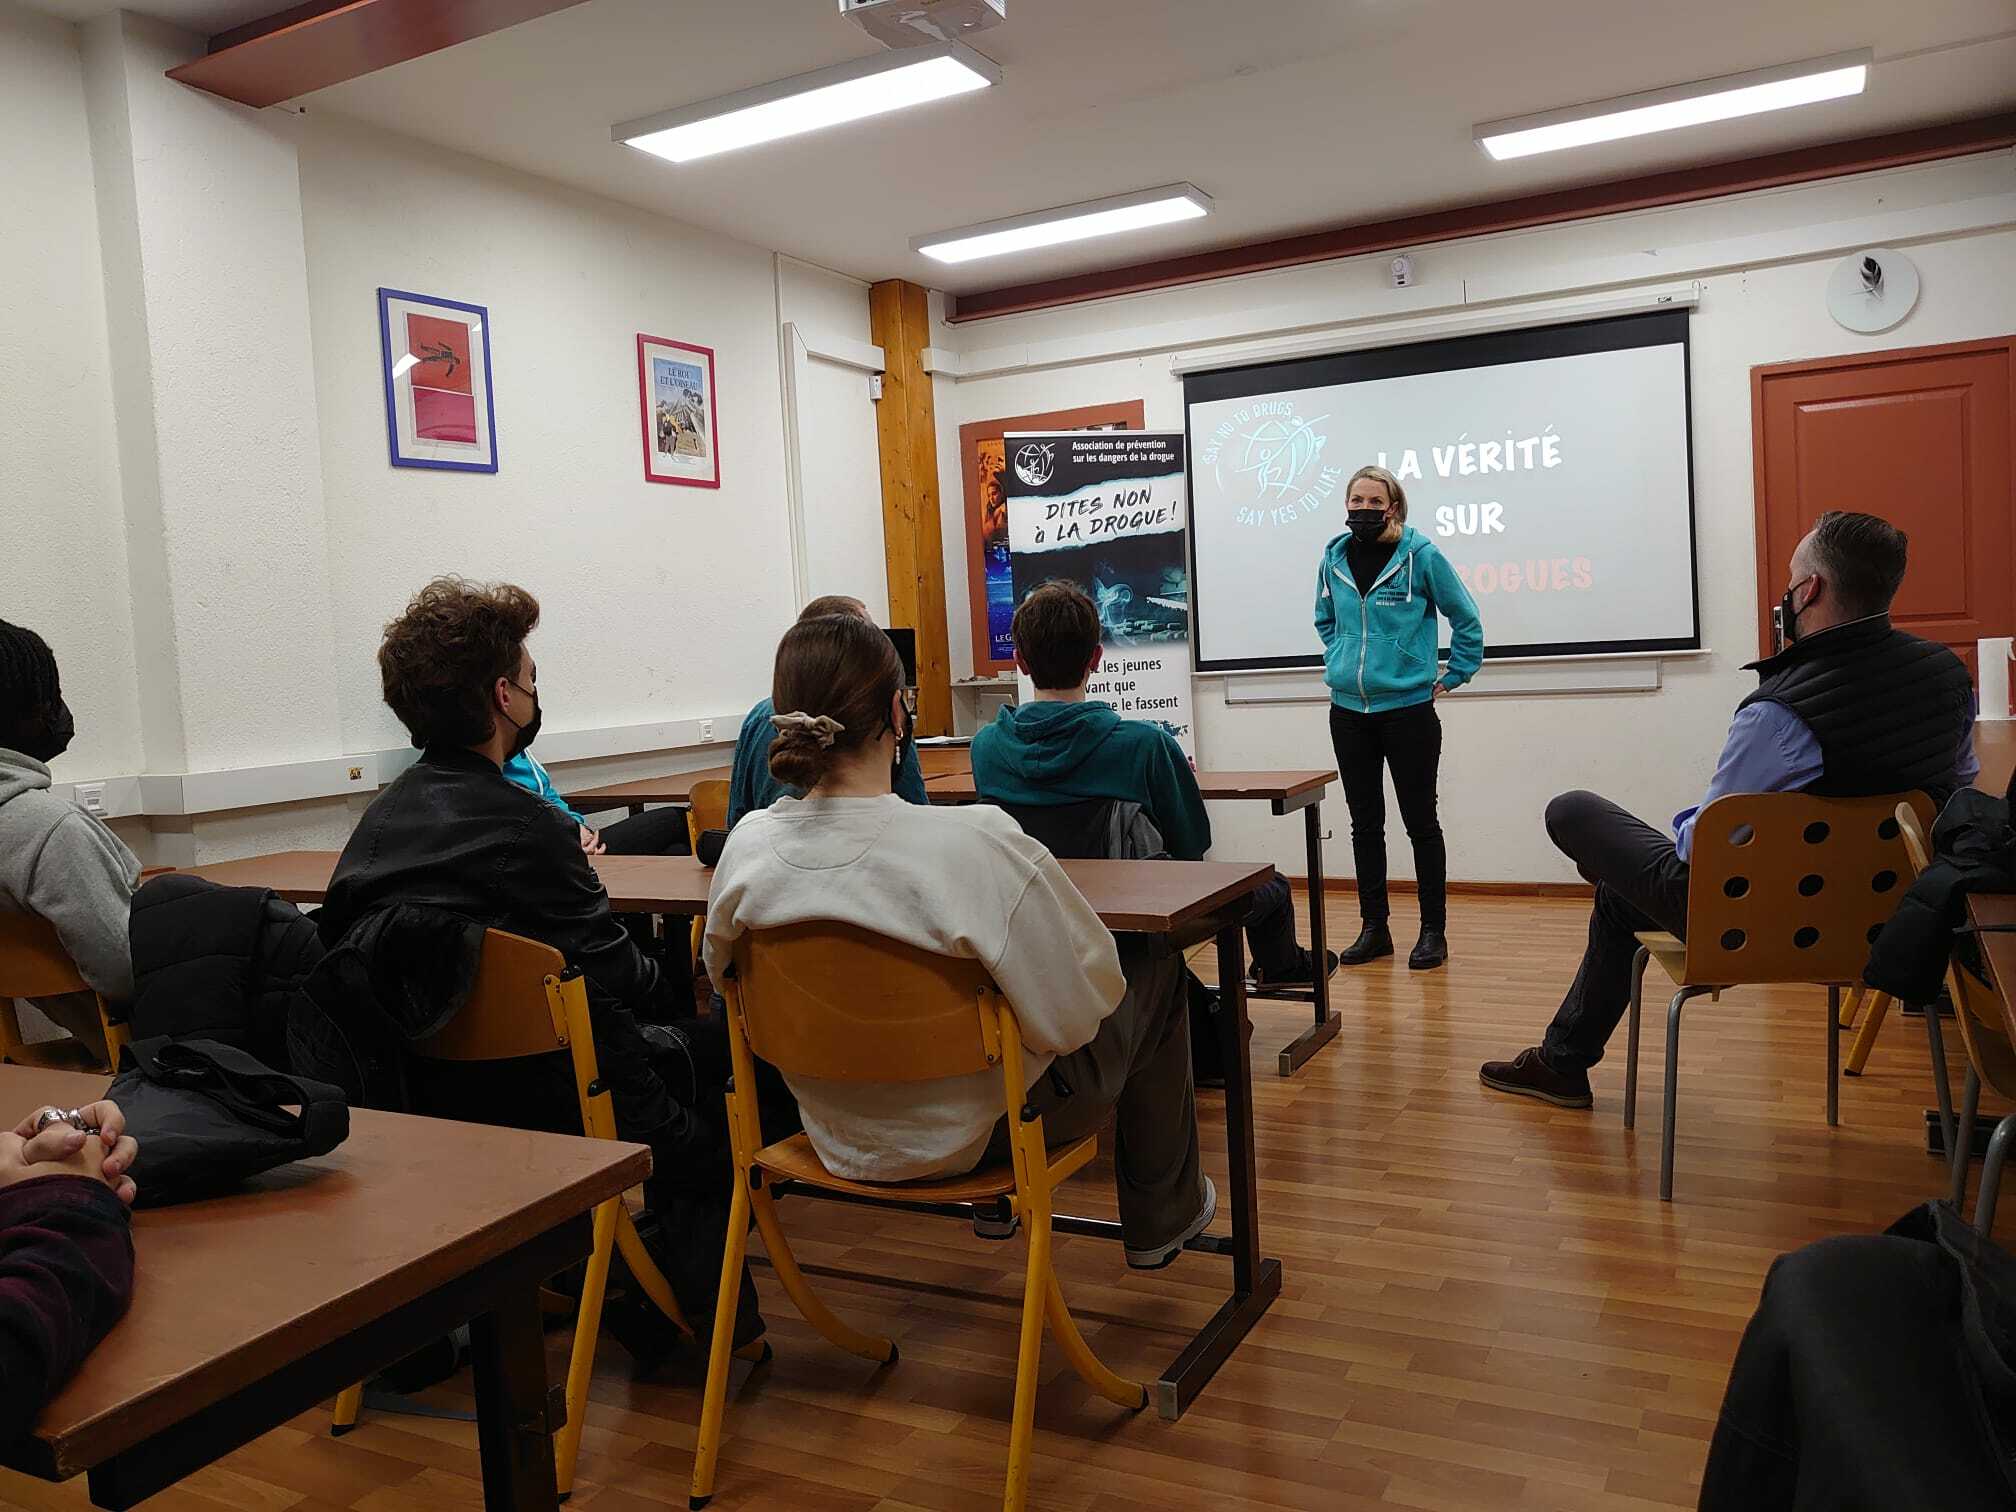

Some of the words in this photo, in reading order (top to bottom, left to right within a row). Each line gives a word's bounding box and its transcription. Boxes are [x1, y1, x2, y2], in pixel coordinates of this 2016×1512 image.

[1201, 439, 1222, 465] SAY
[1216, 422, 1234, 440] NO
[1234, 409, 1250, 425] TO
[1252, 400, 1294, 418] DRUGS
[1072, 440, 1113, 450] Association
[1115, 440, 1125, 450] de
[1126, 440, 1166, 451] prévention
[1072, 454, 1084, 463] sur
[1086, 454, 1097, 462] les
[1099, 453, 1127, 464] dangers
[1130, 453, 1139, 461] de
[1140, 452, 1147, 461] la
[1149, 452, 1175, 463] drogue
[1045, 496, 1103, 520] DITES
[1113, 483, 1152, 509] NON
[1236, 506, 1265, 527] SAY
[1270, 504, 1297, 527] YES
[1298, 492, 1319, 512] TO
[1313, 465, 1343, 498] LIFE
[1435, 501, 1506, 537] SUR
[1034, 526, 1045, 544] à
[1056, 522, 1081, 541] LA
[1454, 555, 1593, 594] ROGUES
[1103, 659, 1119, 673] les
[1122, 659, 1162, 675] jeunes
[1085, 681, 1111, 693] vant
[1114, 680, 1136, 695] que
[1121, 698, 1132, 711] le
[1136, 696, 1178, 710] fassent
